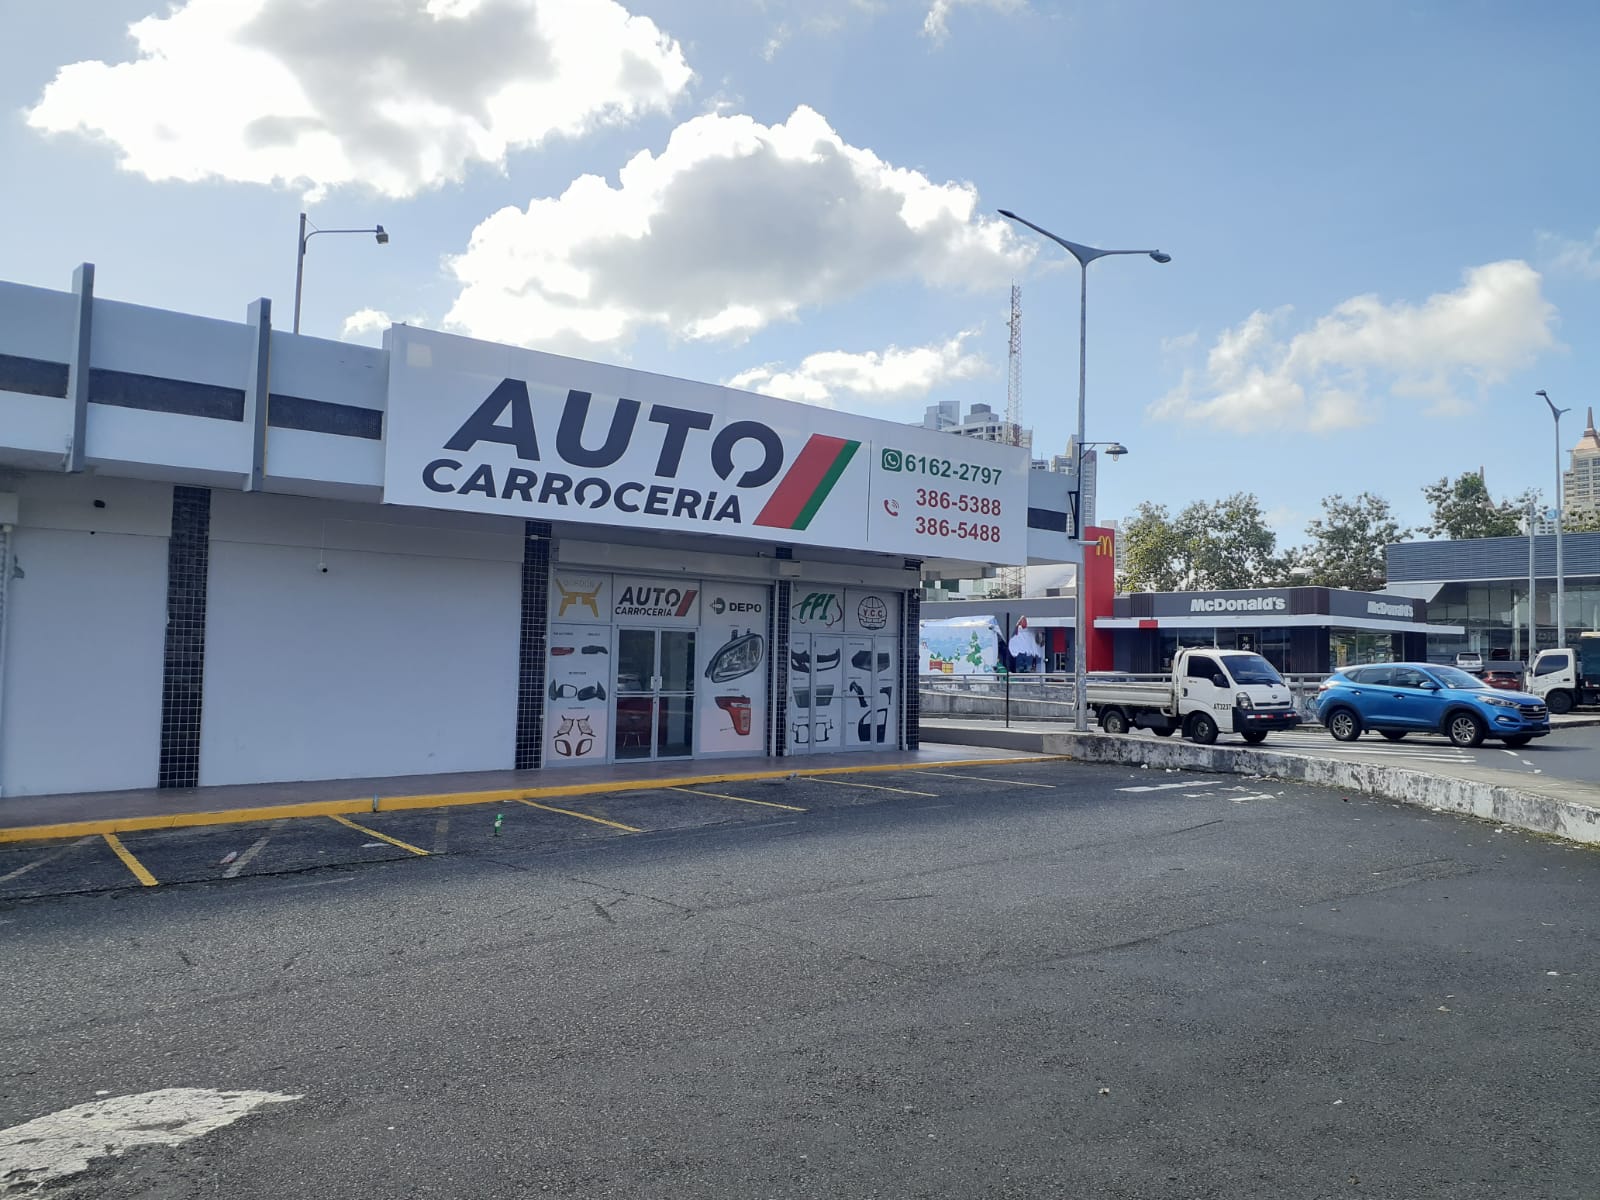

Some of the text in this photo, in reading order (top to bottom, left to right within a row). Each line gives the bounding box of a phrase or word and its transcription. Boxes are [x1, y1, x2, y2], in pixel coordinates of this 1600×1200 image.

[442, 377, 784, 488] AUTO
[905, 454, 1002, 485] 6162-2797
[916, 488, 1001, 516] 386-5388
[915, 516, 1001, 543] 386-5488
[618, 586, 681, 607] AUTO
[729, 602, 762, 613] DEPO
[800, 593, 835, 620] FPI
[1190, 597, 1286, 612] McDonald's
[615, 606, 672, 617] CARROCERIA
